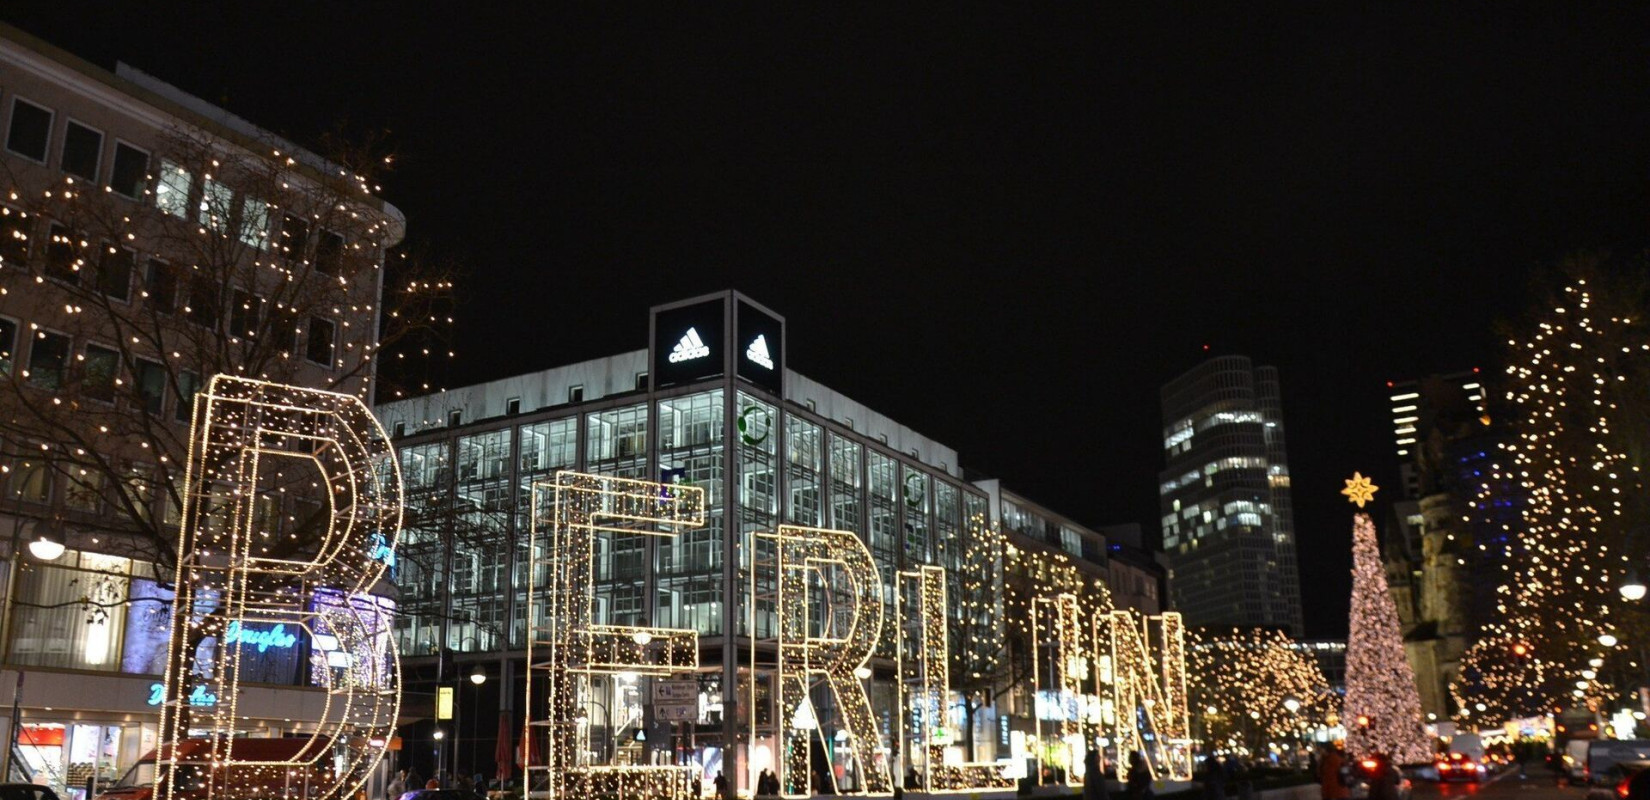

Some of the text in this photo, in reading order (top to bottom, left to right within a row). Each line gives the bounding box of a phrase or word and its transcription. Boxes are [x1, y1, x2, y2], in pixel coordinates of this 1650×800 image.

[669, 346, 709, 363] adidas
[154, 373, 1193, 800] BERLIN
[226, 620, 296, 653] Douglas
